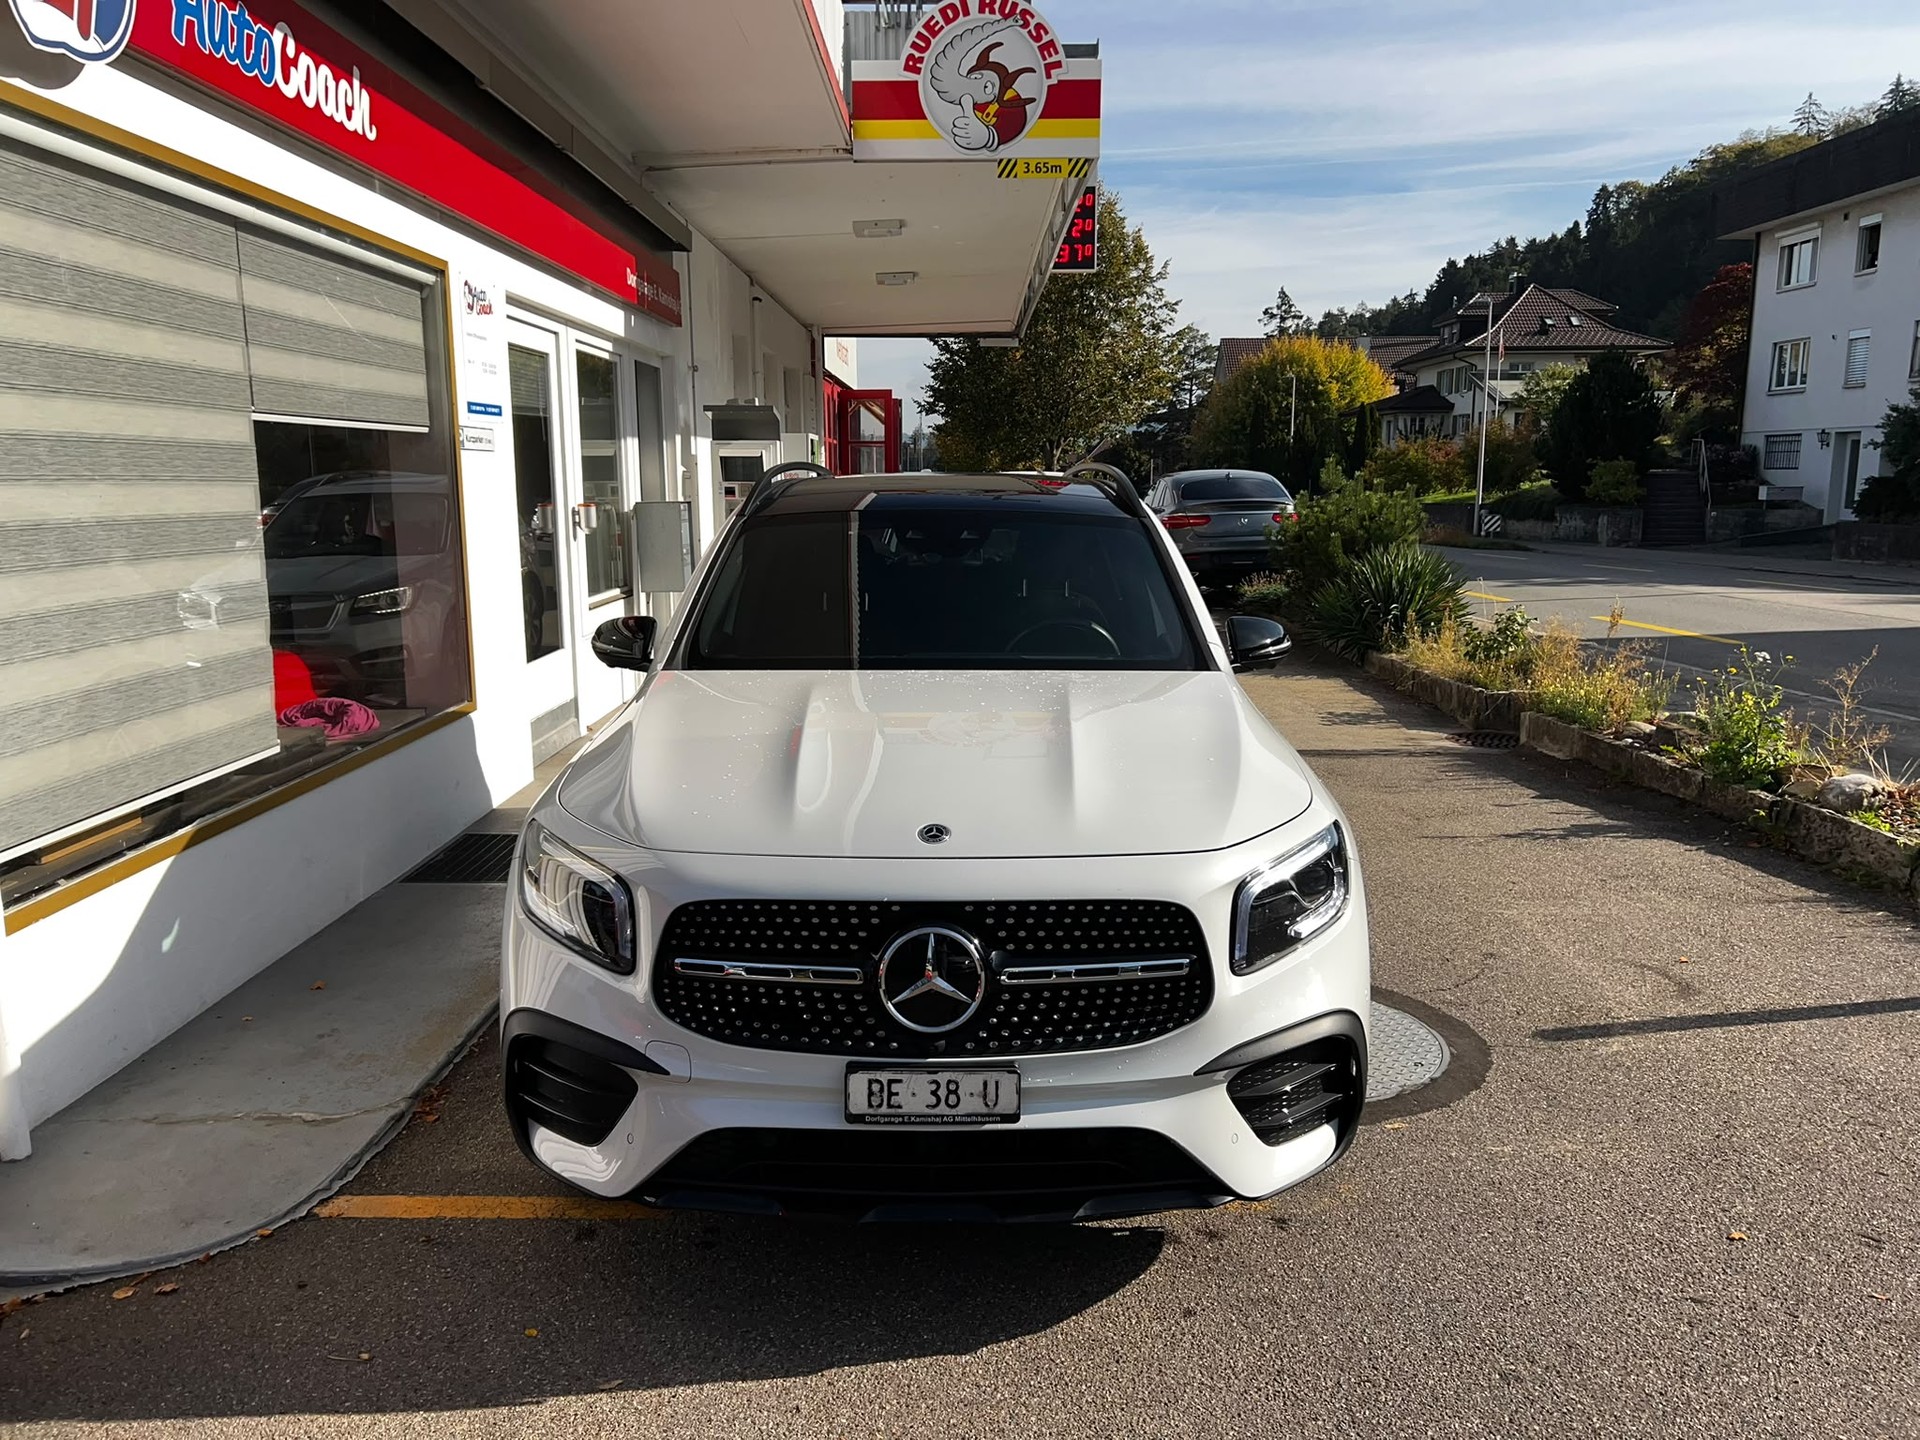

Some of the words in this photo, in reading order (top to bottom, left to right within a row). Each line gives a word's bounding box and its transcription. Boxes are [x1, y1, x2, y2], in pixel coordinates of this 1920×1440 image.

[903, 0, 971, 75] RUEDI
[978, 0, 1063, 80] RUSSEL
[1023, 162, 1063, 175] 3.65m
[867, 1079, 903, 1109] BE
[925, 1079, 961, 1109] 38
[865, 1115, 903, 1123] Dorfgarage
[954, 1114, 1001, 1122] Mittelhäusern
